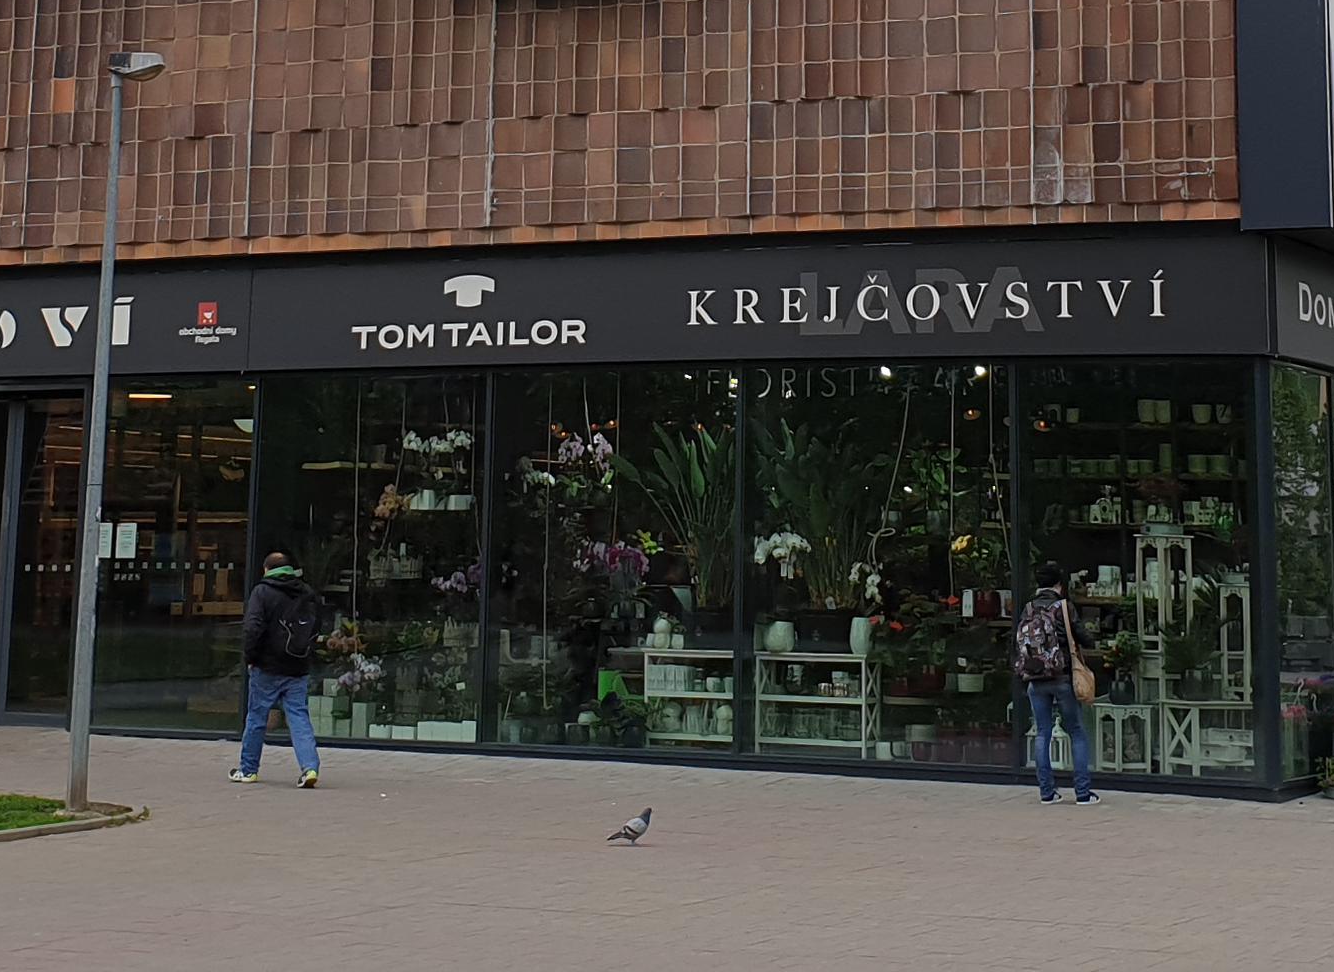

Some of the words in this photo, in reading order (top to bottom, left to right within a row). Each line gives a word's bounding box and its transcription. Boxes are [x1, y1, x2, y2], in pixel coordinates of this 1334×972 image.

[686, 269, 1165, 326] KREJČOVSTVÍ
[799, 266, 1046, 336] LARA
[351, 324, 435, 350] TOM
[442, 320, 586, 348] TAILOR
